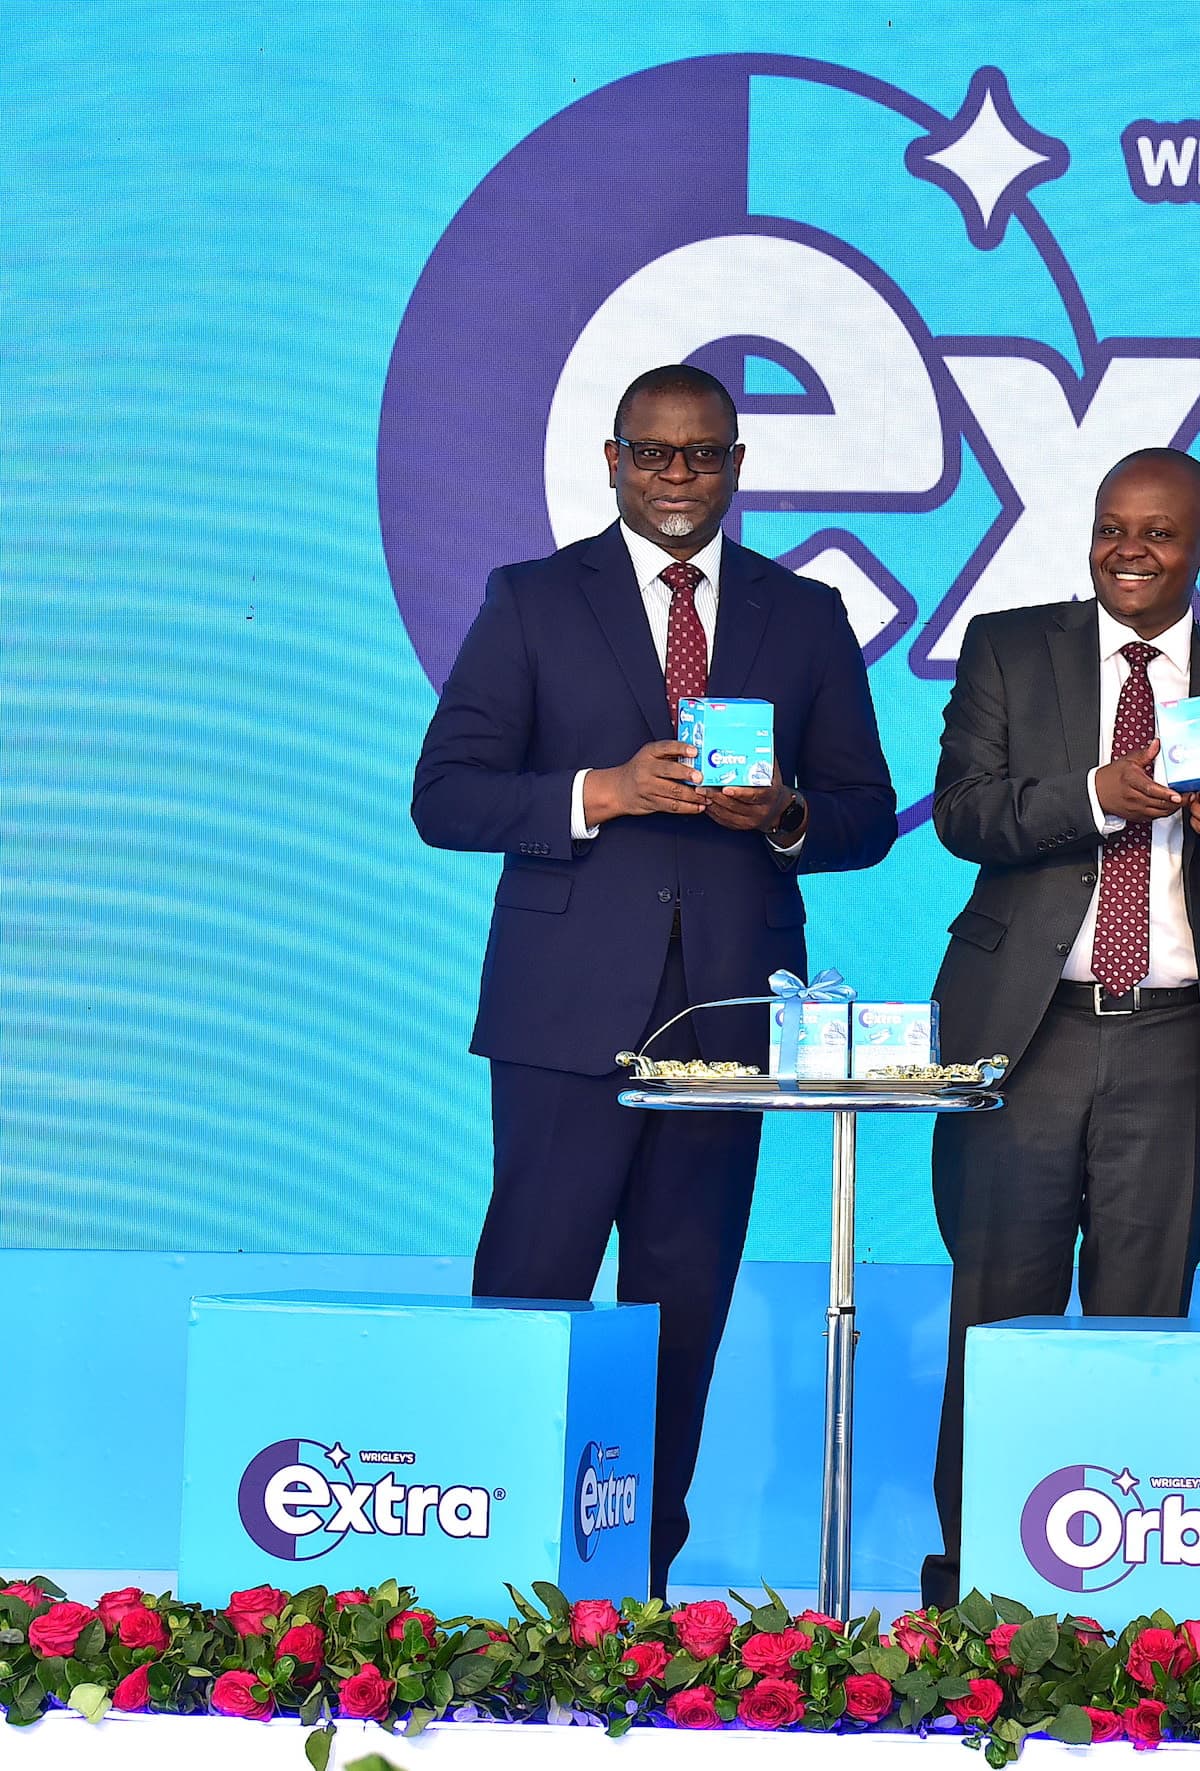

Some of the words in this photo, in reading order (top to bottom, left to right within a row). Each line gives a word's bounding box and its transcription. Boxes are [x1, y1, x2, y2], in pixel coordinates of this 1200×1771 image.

[360, 1451, 415, 1463] WRIGLEY'S
[264, 1463, 490, 1538] extra
[580, 1468, 637, 1536] extra
